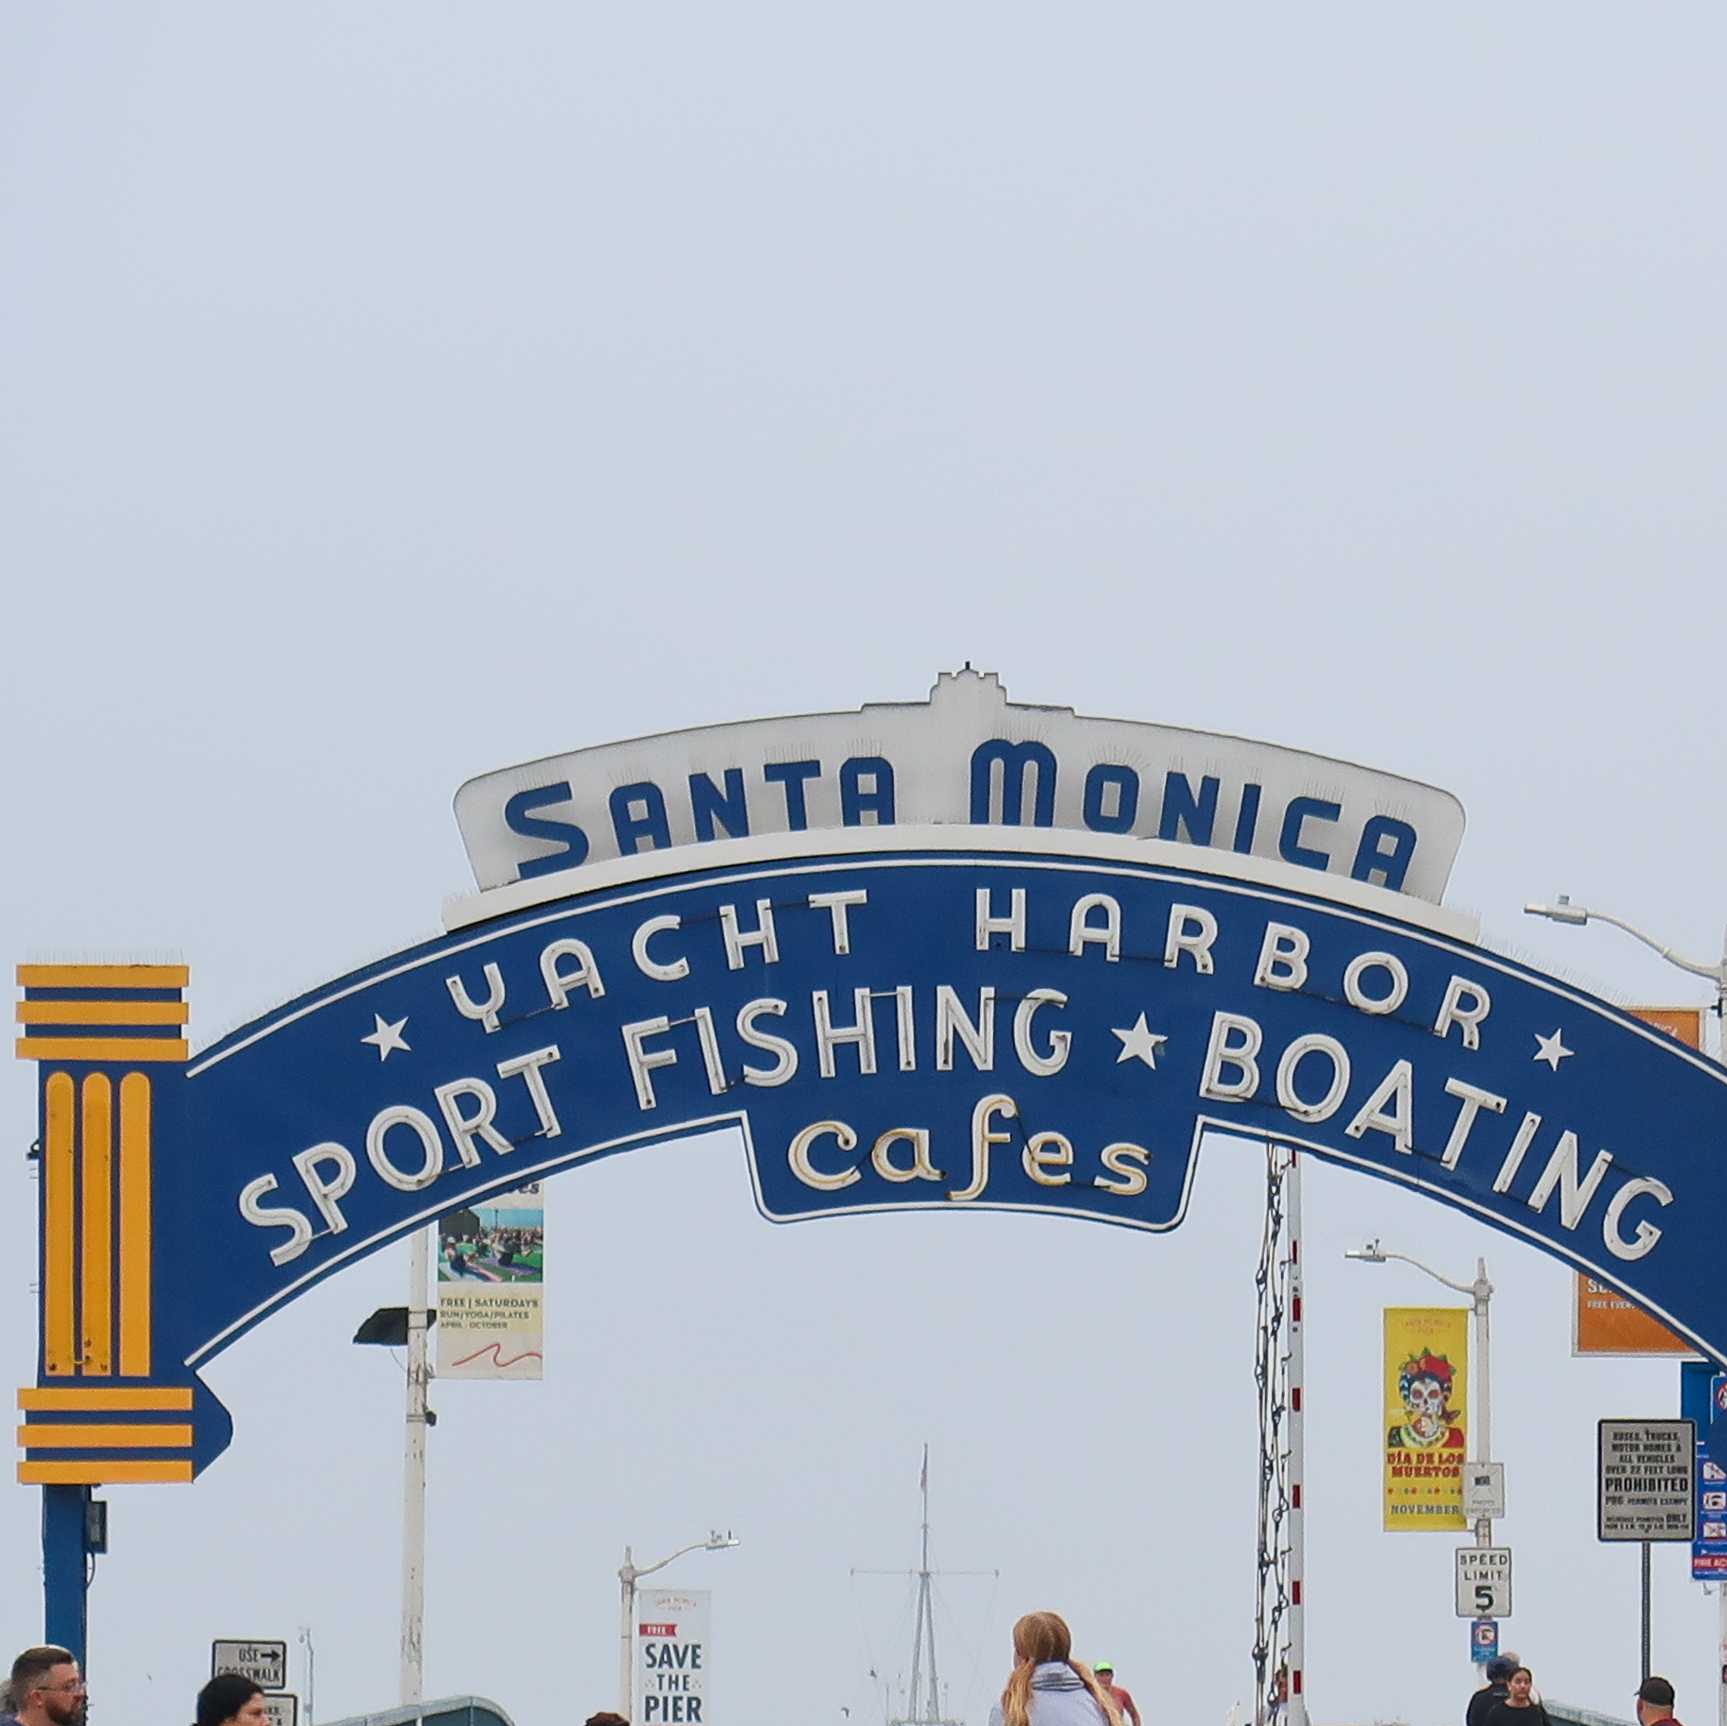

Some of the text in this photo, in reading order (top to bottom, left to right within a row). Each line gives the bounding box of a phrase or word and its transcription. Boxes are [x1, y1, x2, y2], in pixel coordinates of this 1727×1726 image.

[504, 739, 1418, 891] SANTA MONICA
[446, 887, 1492, 1050] YACHT HARBOR
[238, 986, 1674, 1267] SPORT FISHING BOATING
[474, 1298, 539, 1308] SATURDAYS
[1416, 1452, 1434, 1465] DE
[1438, 1452, 1464, 1465] LOS
[1391, 1466, 1460, 1479] MUERTOS
[1605, 1478, 1688, 1492] PROHIBITED
[1391, 1504, 1460, 1515] NOVEMBER
[1460, 1555, 1508, 1566] SPEED
[1464, 1570, 1503, 1581] LIMIT
[1475, 1585, 1494, 1611] 5
[239, 1648, 259, 1662] USE
[645, 1643, 702, 1669] SAVE
[656, 1674, 690, 1691] THE
[644, 1695, 702, 1723] PIER
